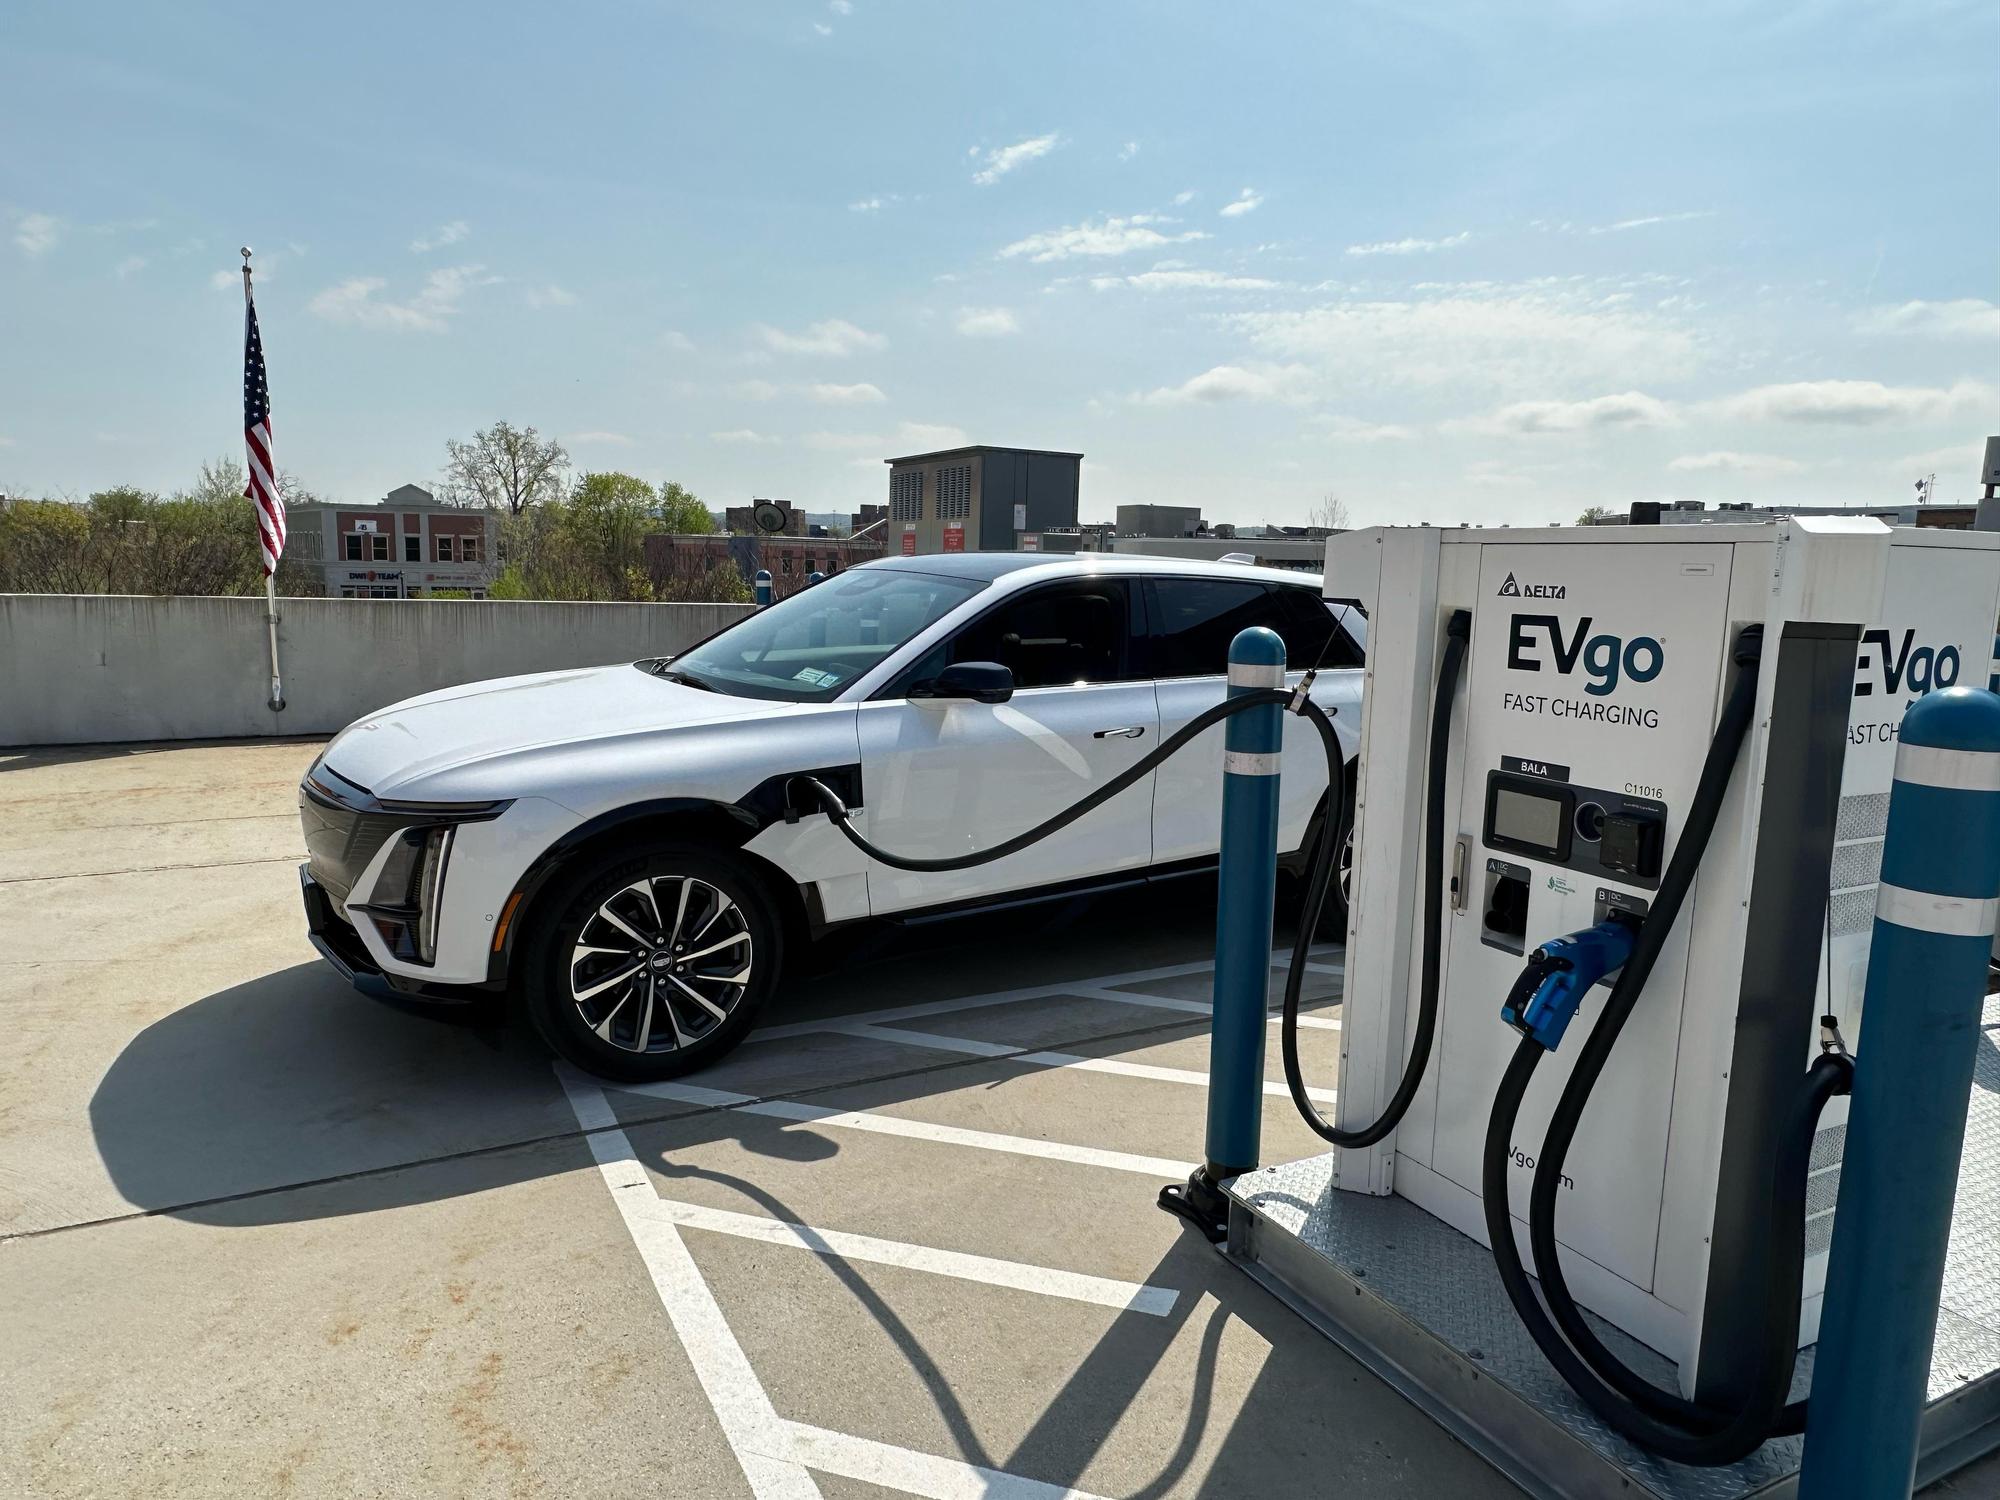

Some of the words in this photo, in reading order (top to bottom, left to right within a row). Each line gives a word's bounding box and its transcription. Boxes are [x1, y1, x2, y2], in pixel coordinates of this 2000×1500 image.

[1524, 584, 1566, 599] DELTA
[1507, 613, 1664, 697] EVgo
[1504, 693, 1548, 714] FAST
[1551, 698, 1659, 729] CHARGING
[1520, 761, 1548, 776] BALA
[1624, 782, 1663, 799] C11016
[1599, 891, 1605, 900] B
[1611, 892, 1622, 901] DC
